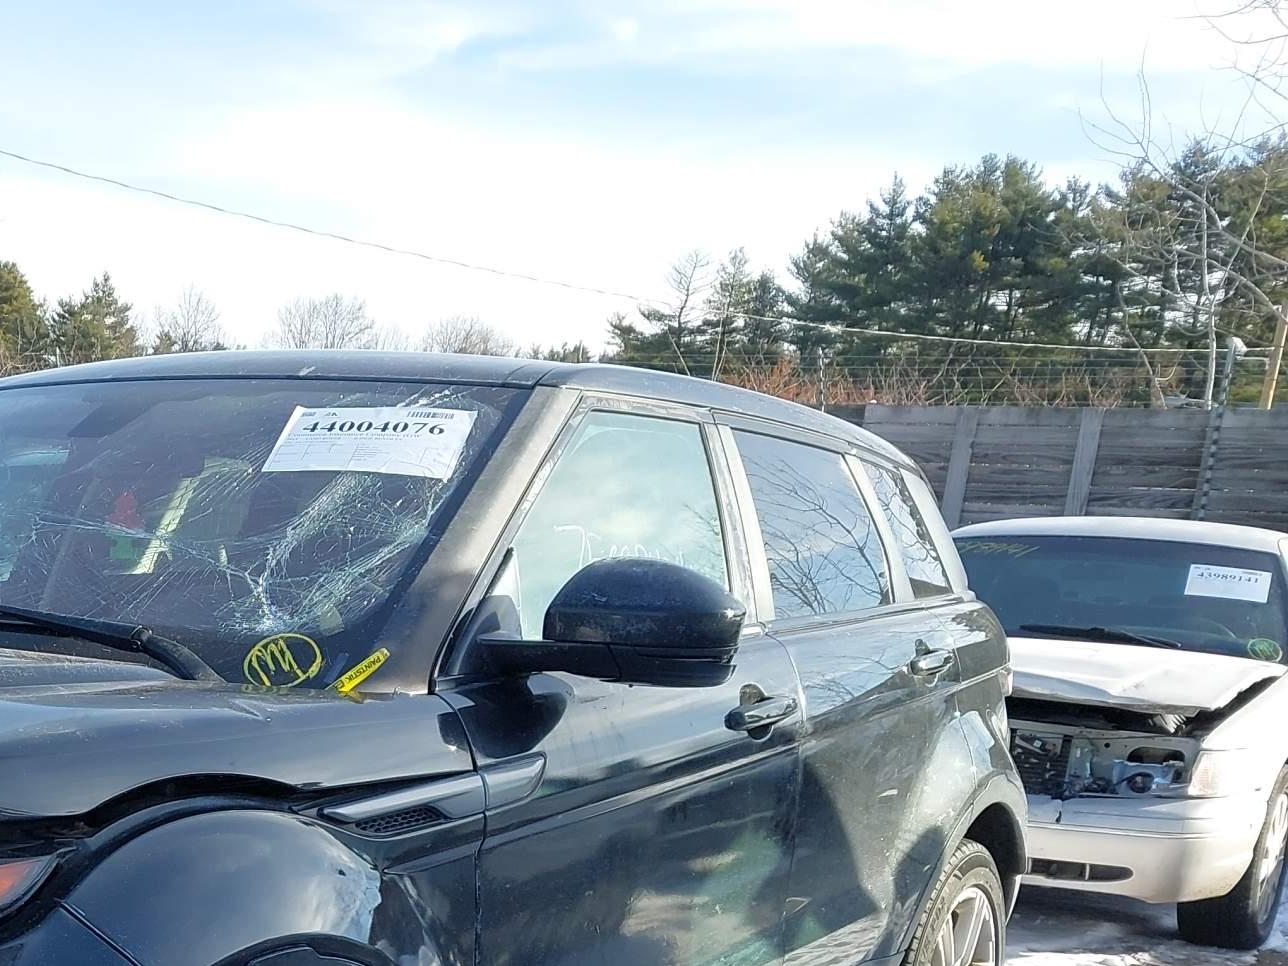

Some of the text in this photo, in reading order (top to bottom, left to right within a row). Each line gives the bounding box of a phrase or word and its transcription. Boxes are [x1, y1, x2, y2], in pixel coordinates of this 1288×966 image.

[302, 421, 446, 436] 44004076
[1198, 572, 1259, 583] 43989141
[344, 655, 382, 683] PAINTSTIK
